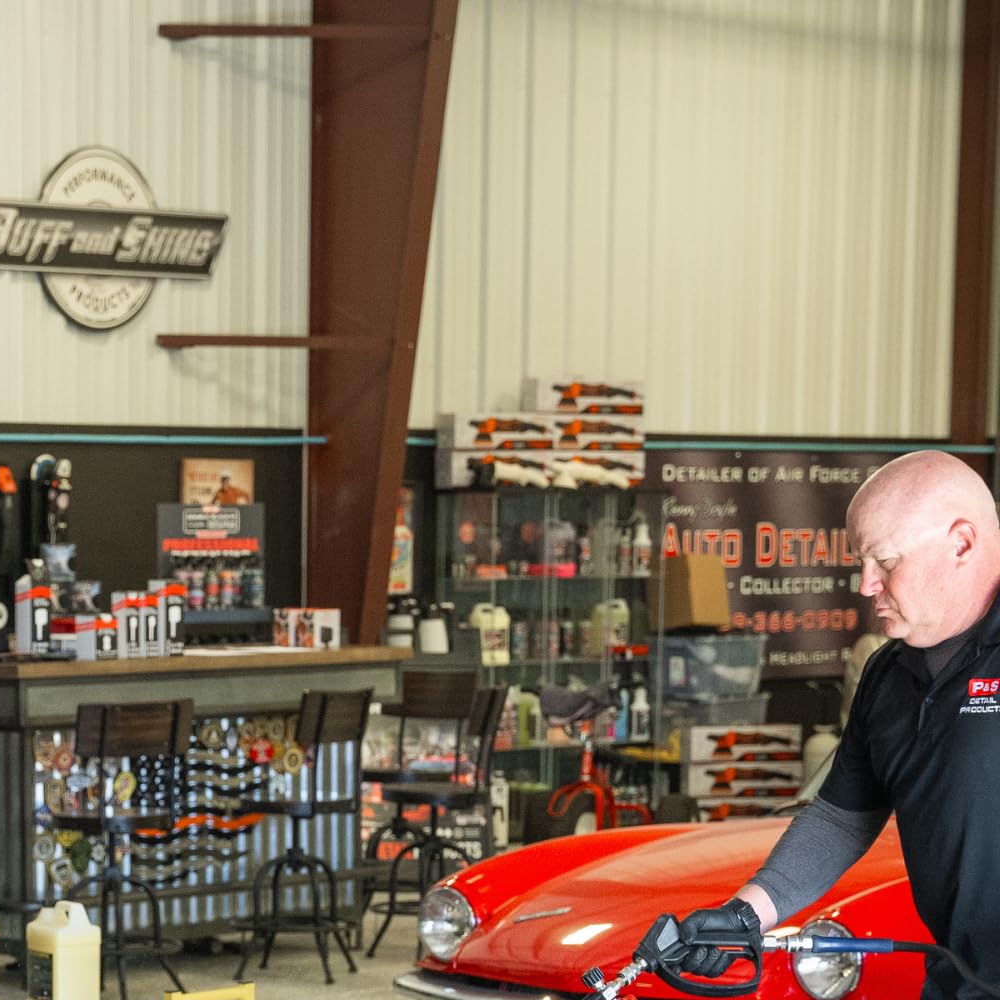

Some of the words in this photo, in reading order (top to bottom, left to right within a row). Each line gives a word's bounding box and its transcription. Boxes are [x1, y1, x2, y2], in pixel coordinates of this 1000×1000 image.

[971, 681, 999, 693] P&S
[969, 696, 997, 704] DETAIL
[960, 705, 1000, 714] PRODUCT
